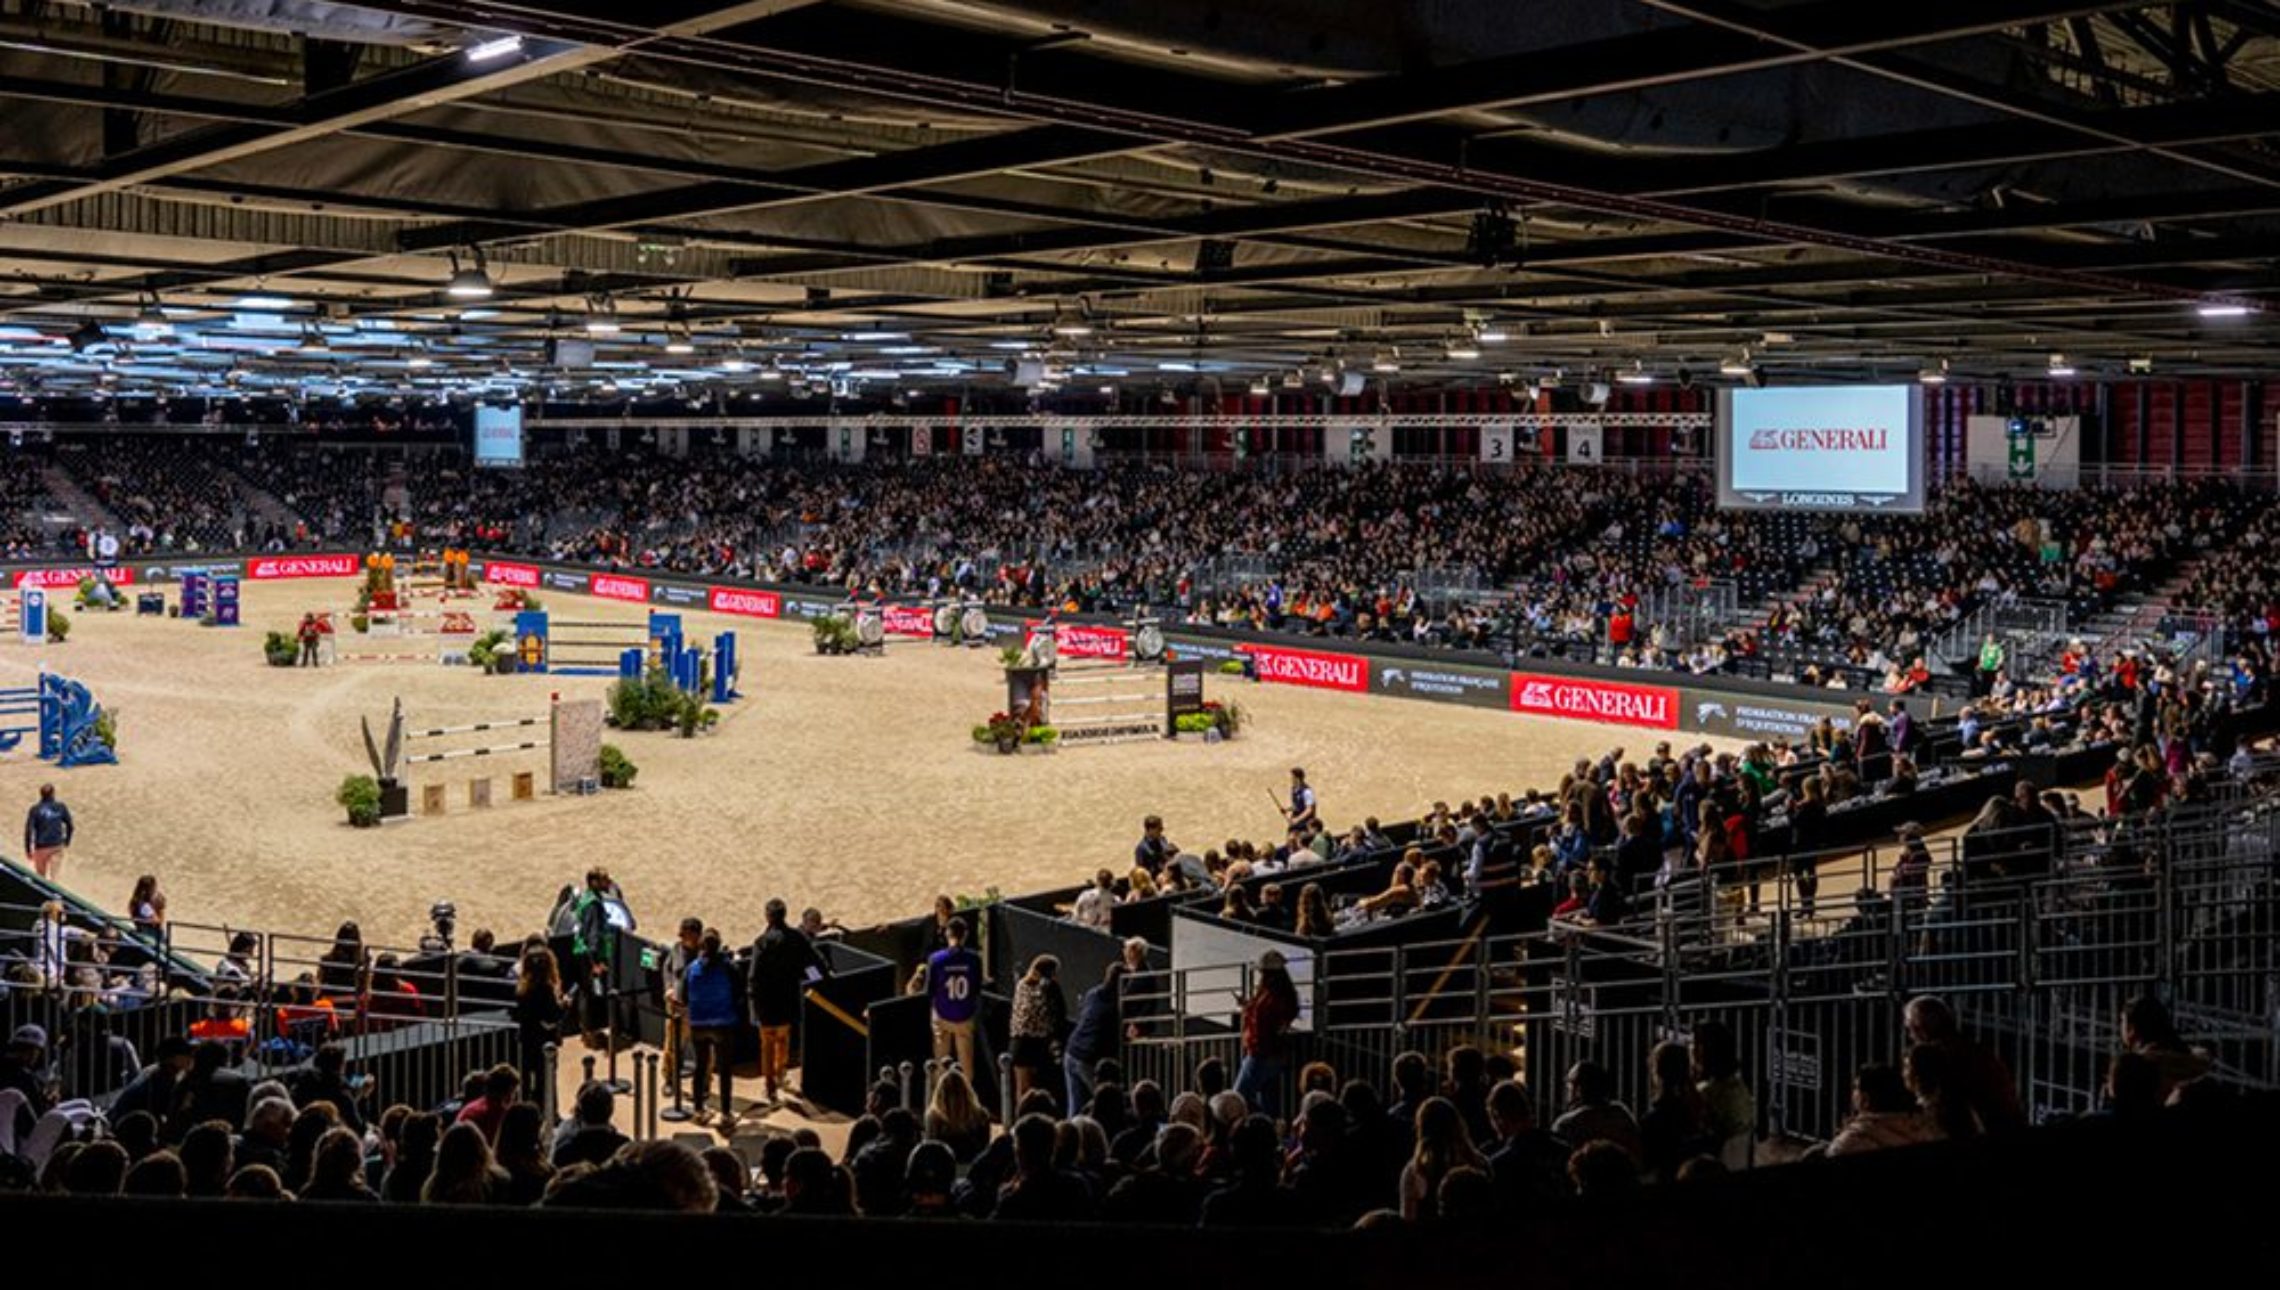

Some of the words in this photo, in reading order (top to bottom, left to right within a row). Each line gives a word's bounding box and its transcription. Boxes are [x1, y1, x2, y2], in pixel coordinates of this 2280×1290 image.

[1490, 439, 1502, 458] 3
[1577, 440, 1590, 457] 4
[1780, 429, 1887, 450] GENERALI
[1782, 492, 1854, 506] LONGINES
[279, 559, 351, 574] GENERALI
[1274, 655, 1358, 685] GENERALI
[1554, 685, 1667, 721] GENERALI
[945, 976, 969, 1000] 10
